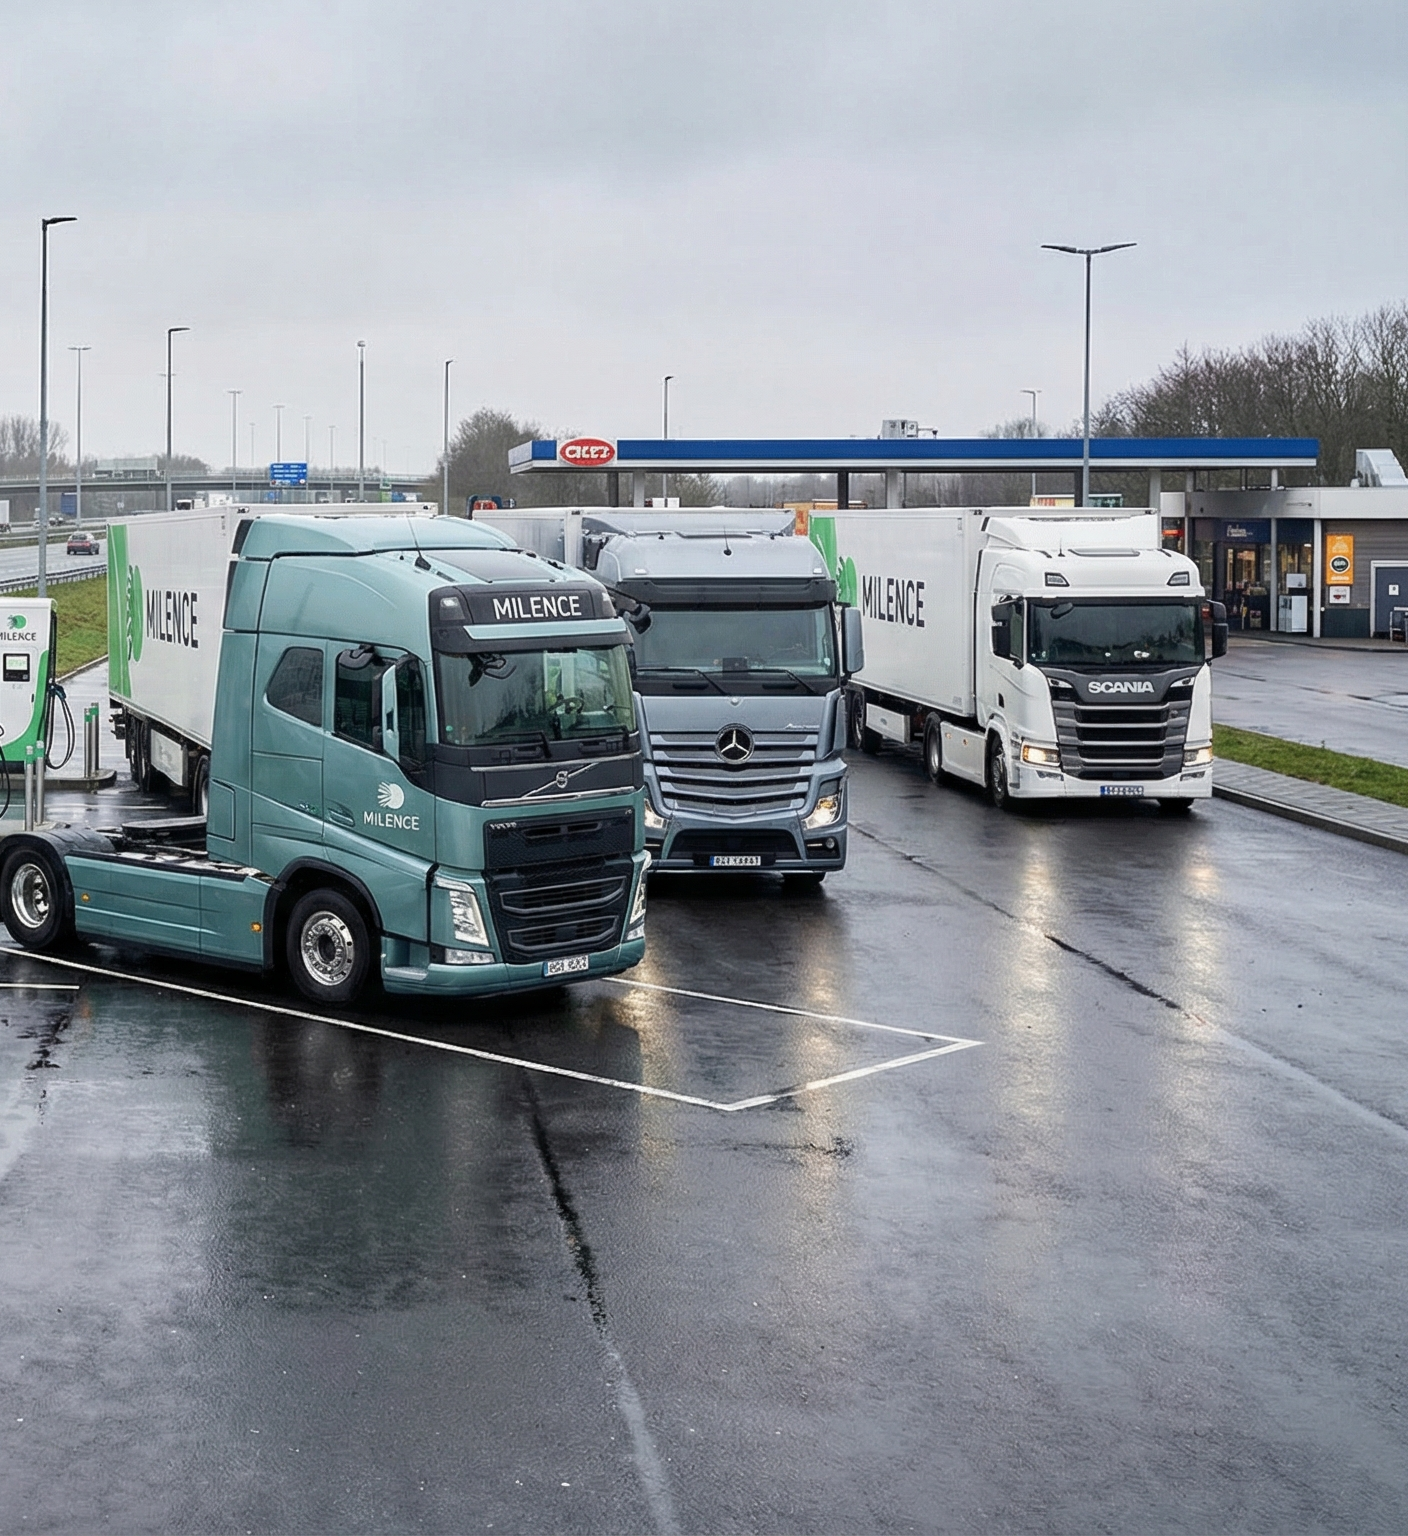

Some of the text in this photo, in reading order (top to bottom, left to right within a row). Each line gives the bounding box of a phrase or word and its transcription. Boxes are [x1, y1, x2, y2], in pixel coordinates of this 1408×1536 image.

[492, 594, 582, 621] MILENCE
[861, 575, 925, 629] MILENCE
[146, 589, 199, 649] MILENCE
[1088, 681, 1154, 694] SCANIA
[363, 811, 420, 831] MILENCE
